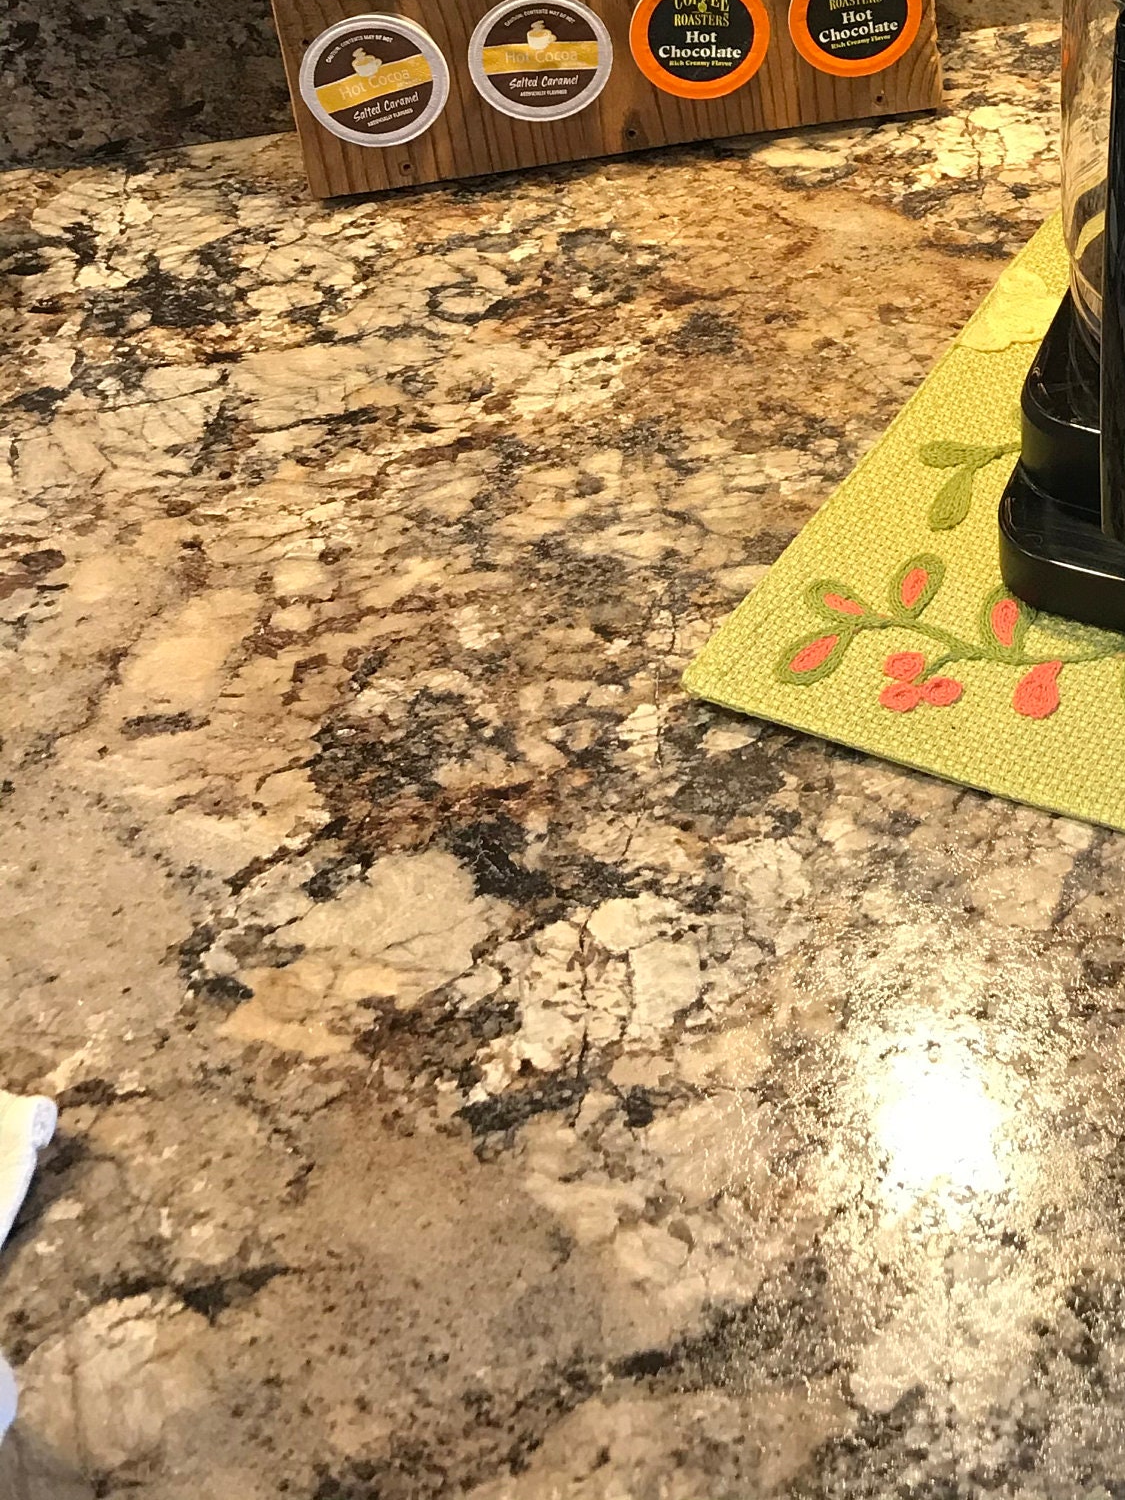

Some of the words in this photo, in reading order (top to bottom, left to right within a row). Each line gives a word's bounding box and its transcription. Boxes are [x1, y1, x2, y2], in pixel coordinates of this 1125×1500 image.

[674, 14, 730, 27] ROASTERS
[842, 9, 873, 24] Hot
[685, 31, 717, 43] Hot
[819, 21, 898, 43] Chocolate
[659, 45, 742, 58] Chocolate
[509, 76, 538, 90] Salted
[541, 75, 579, 87] Caramel
[354, 102, 381, 122] Salted
[384, 91, 419, 112] Caramel
